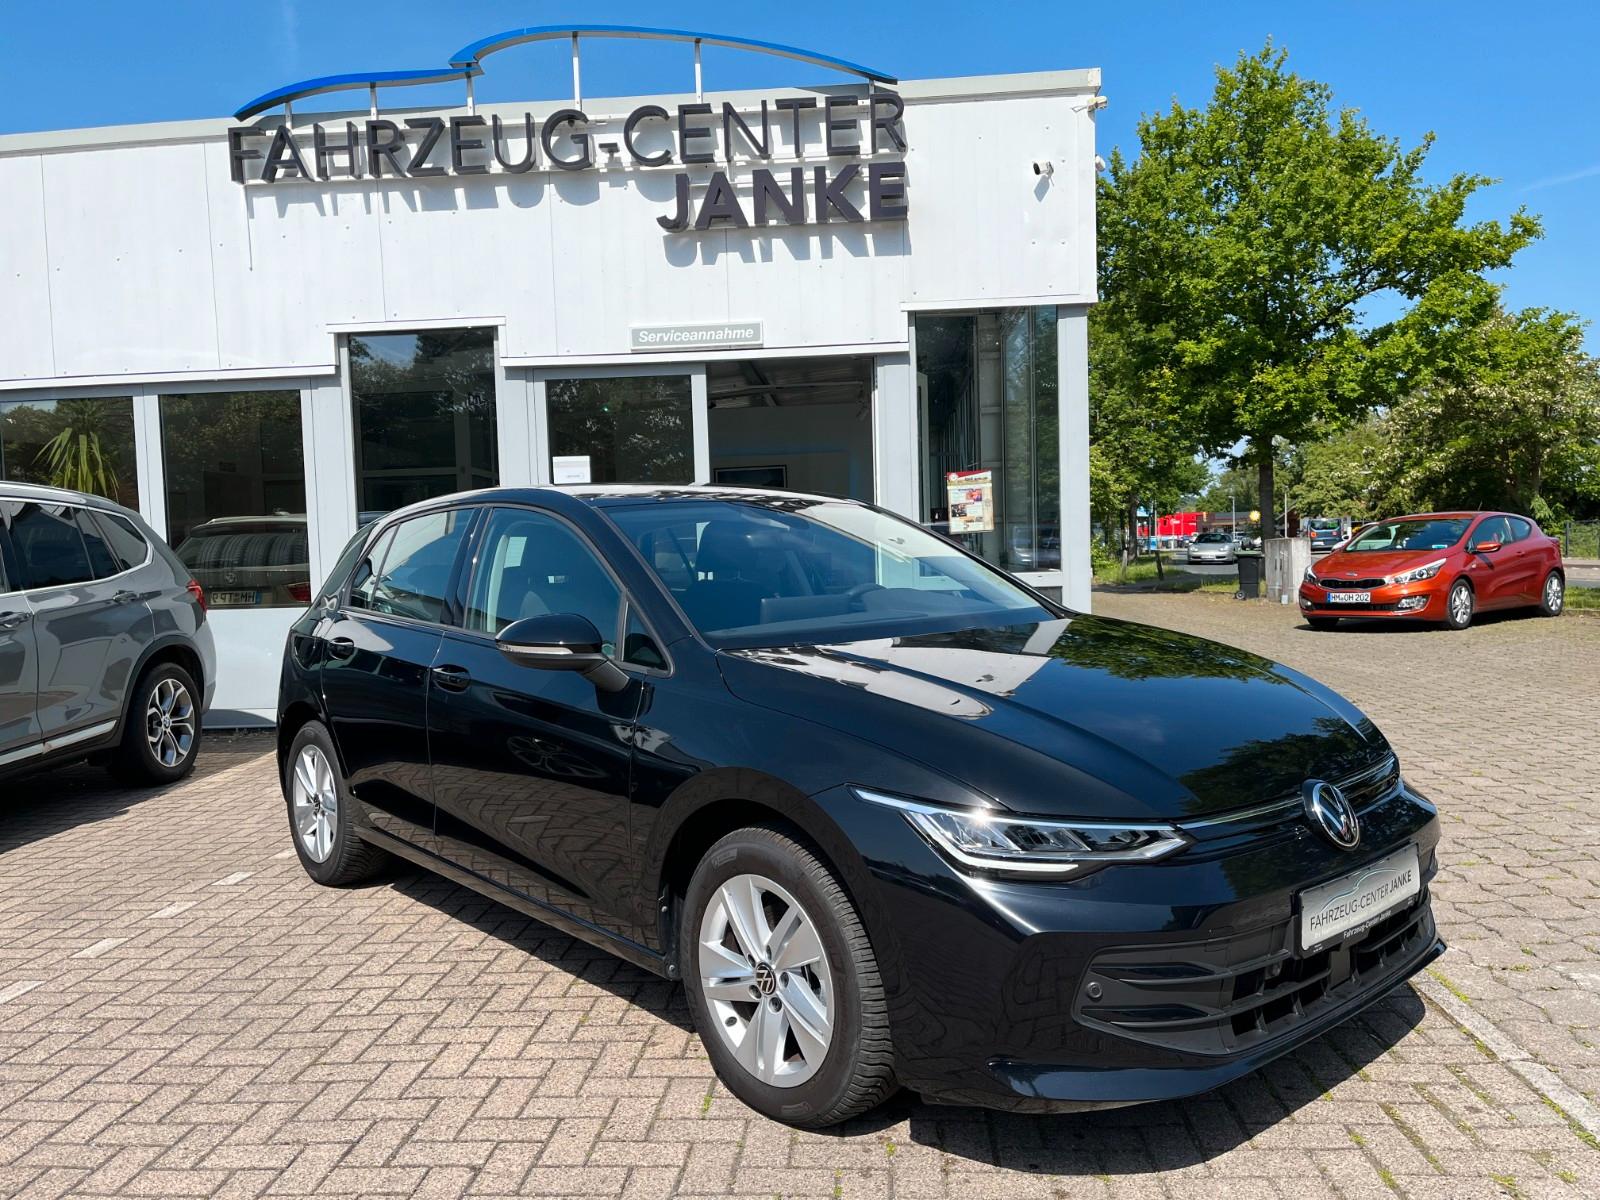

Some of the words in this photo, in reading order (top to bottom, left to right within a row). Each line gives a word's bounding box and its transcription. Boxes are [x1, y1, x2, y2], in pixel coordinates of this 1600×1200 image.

[228, 92, 906, 185] FAHRZEUG-CENTER
[657, 161, 907, 232] JANKE
[639, 327, 754, 343] Serviceannahme
[1355, 593, 1370, 602] 202
[1310, 887, 1389, 931] FAHRZEUG-CENTER
[1389, 869, 1412, 893] JANKE
